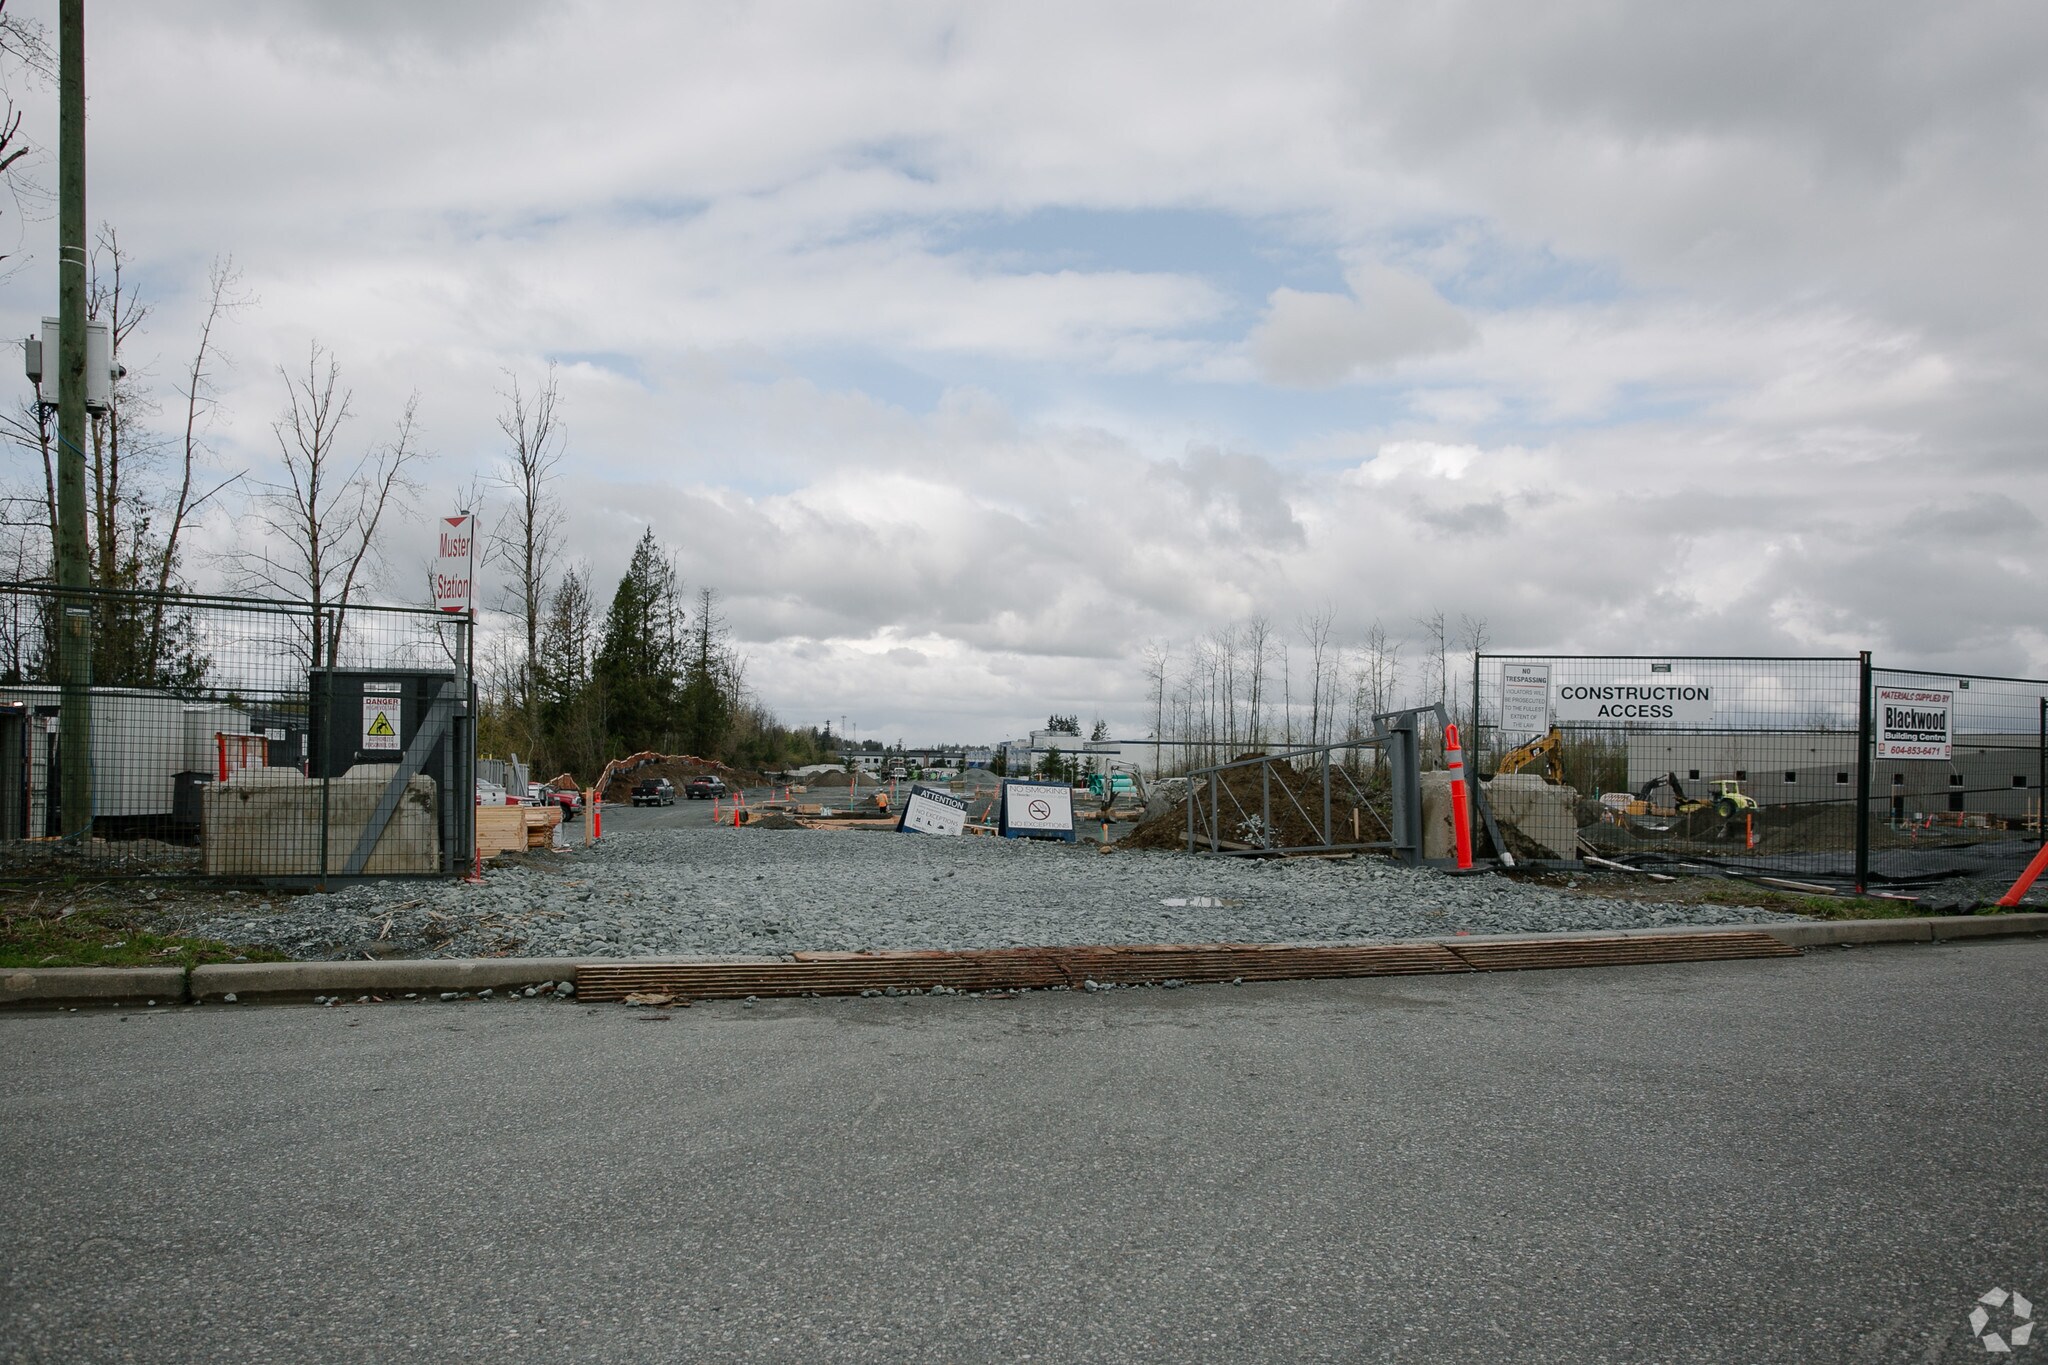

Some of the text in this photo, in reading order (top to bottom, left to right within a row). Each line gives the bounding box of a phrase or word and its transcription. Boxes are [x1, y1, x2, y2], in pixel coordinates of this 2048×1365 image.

[439, 533, 470, 558] Muster
[437, 573, 469, 599] Station
[1561, 686, 1709, 701] CONSTRUCTION
[1881, 691, 1949, 703] MATERIALS SUPPLIED BY
[1597, 704, 1673, 718] ACCESS
[1886, 707, 1946, 730] Blackwood
[1885, 732, 1946, 742] Building Centre
[1890, 746, 1940, 755] 604-853-6471
[1009, 785, 1068, 795] NO SMOKING
[920, 790, 964, 810] ATTENTION
[925, 811, 959, 827] EXCEPTIONS
